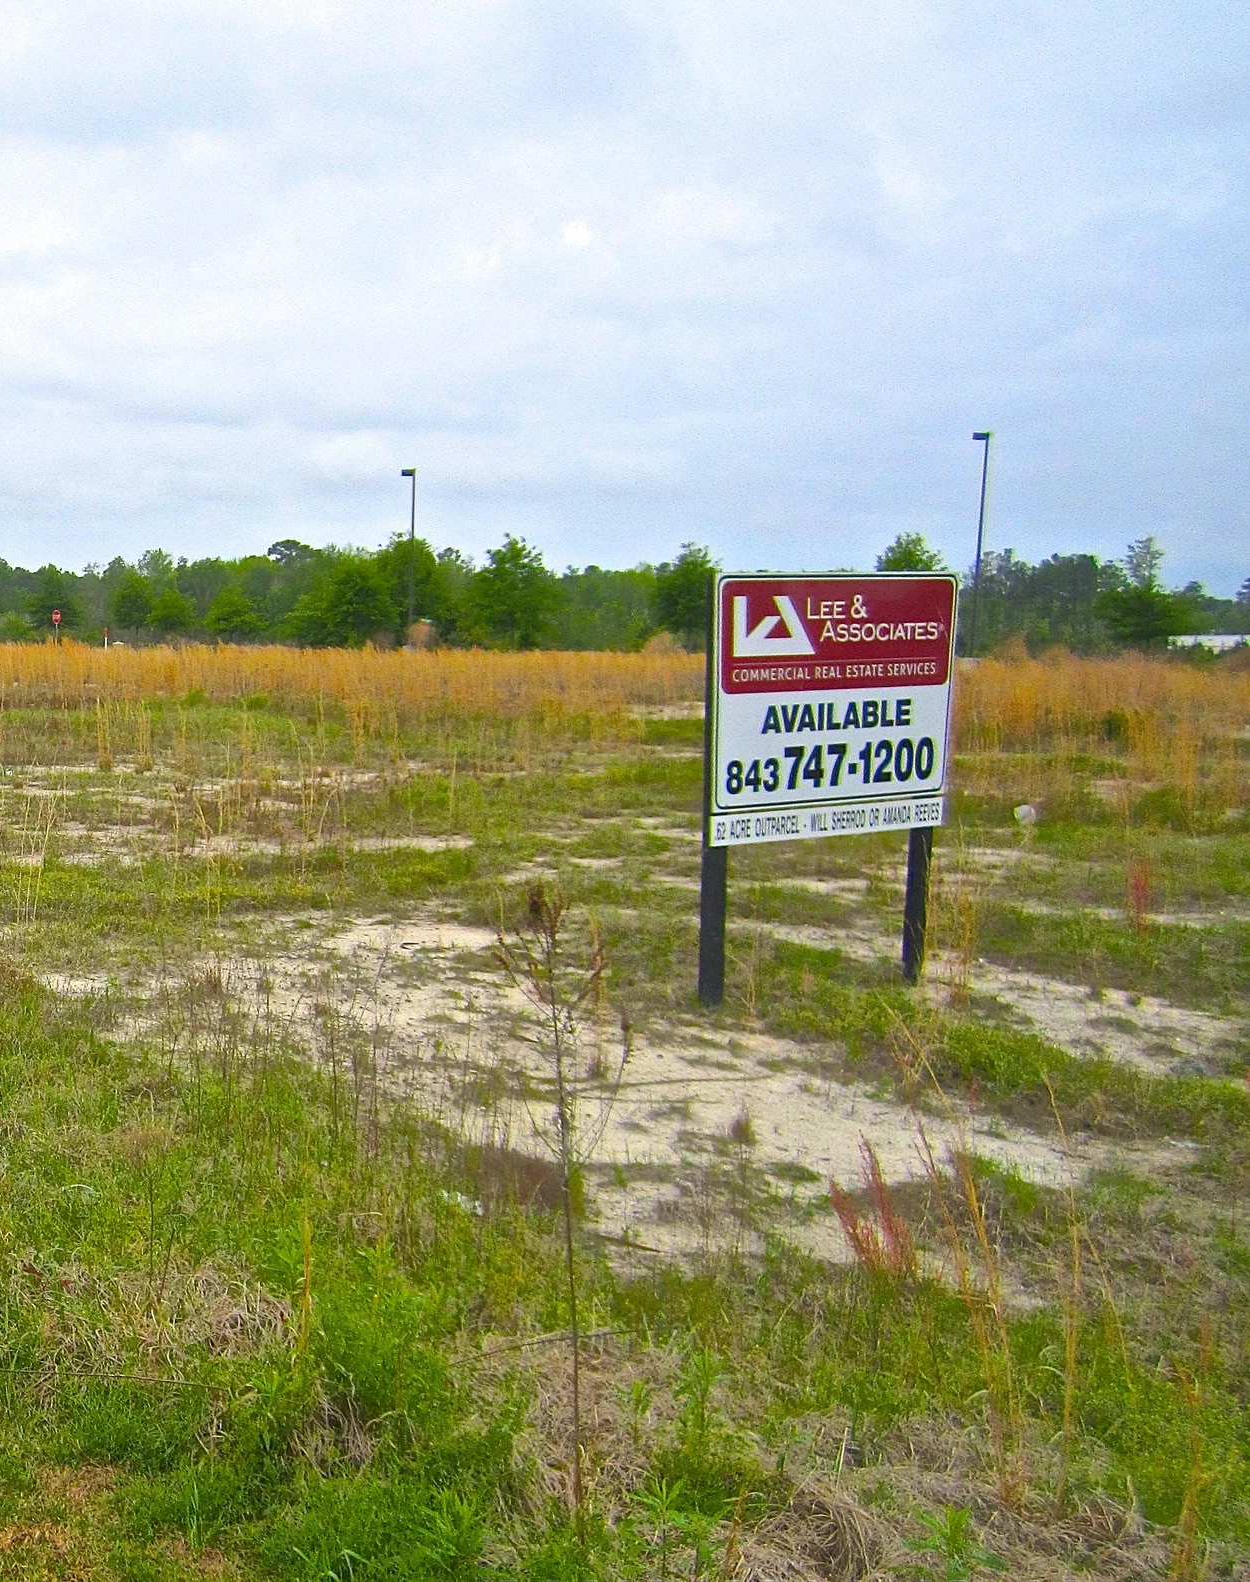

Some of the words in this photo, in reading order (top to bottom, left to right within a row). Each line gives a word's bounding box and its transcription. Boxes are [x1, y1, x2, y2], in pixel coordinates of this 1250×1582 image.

[807, 597, 846, 619] LEE
[851, 595, 867, 618] &
[733, 667, 810, 681] COMMERCIAL
[815, 666, 841, 678] REAL
[846, 664, 883, 677] ESTATE
[888, 662, 936, 676] SERVICES
[762, 699, 911, 734] AVAILABLE
[730, 819, 750, 838] ACRE
[755, 814, 800, 836] OUTPARCEL
[811, 814, 827, 831] WILL
[832, 810, 865, 829] SHERROD
[869, 808, 879, 825] OR
[883, 805, 911, 824] AMANDA
[915, 803, 939, 822] REEVES
